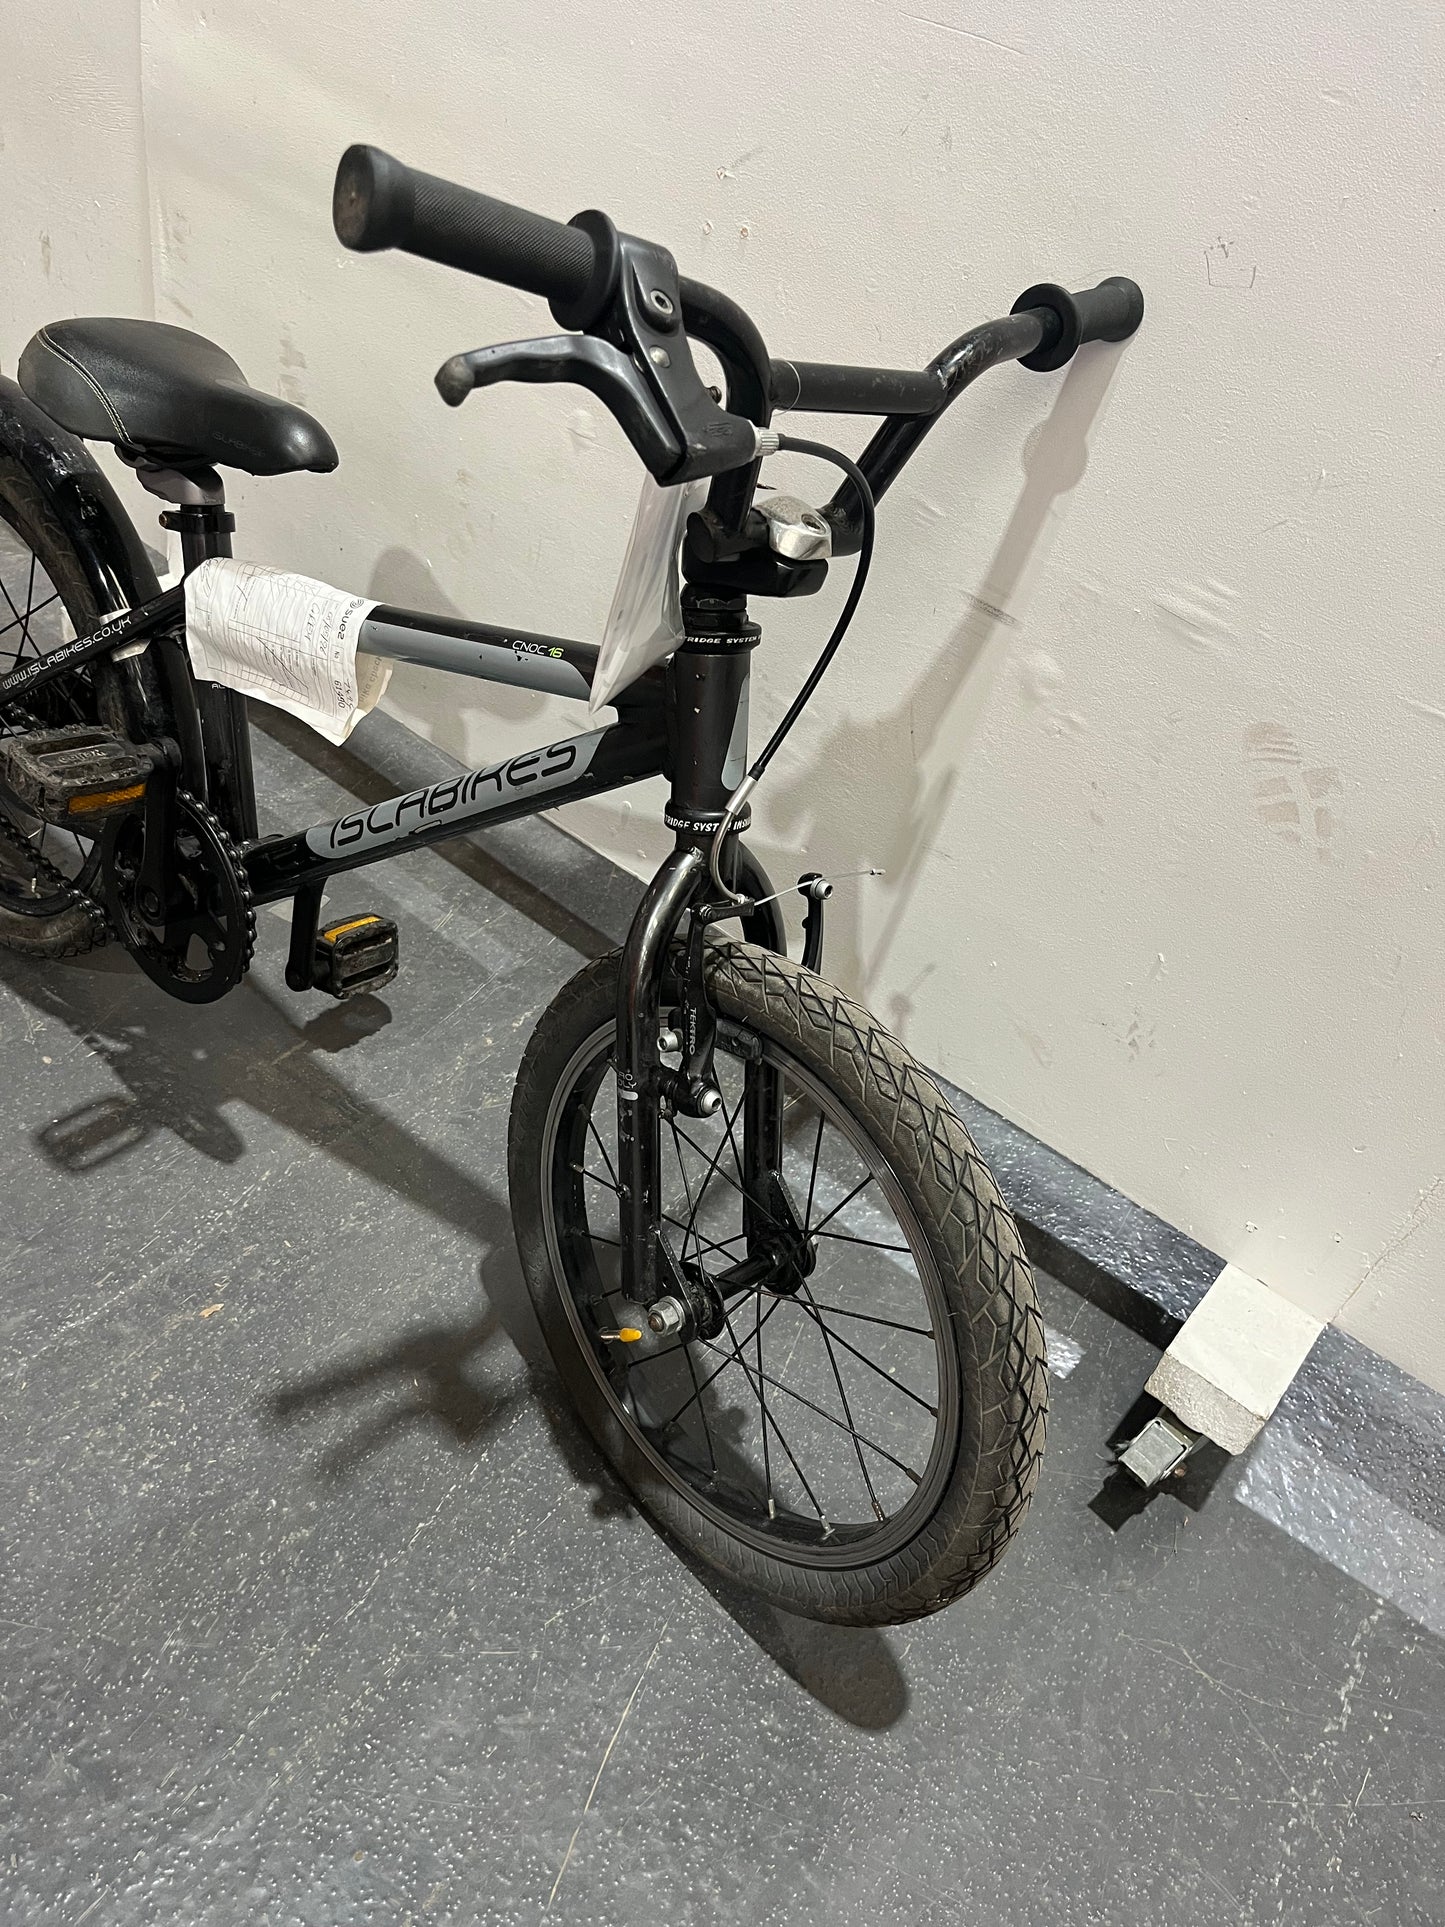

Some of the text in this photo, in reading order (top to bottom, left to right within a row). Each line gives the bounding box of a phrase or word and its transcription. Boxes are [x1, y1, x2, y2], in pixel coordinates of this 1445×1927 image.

[685, 635, 722, 644] RIDGE
[512, 640, 564, 658] CNOC 16
[330, 745, 577, 849] ISLABIKES
[692, 822, 732, 832] SYST
[689, 1007, 697, 1056] TEKTRO
